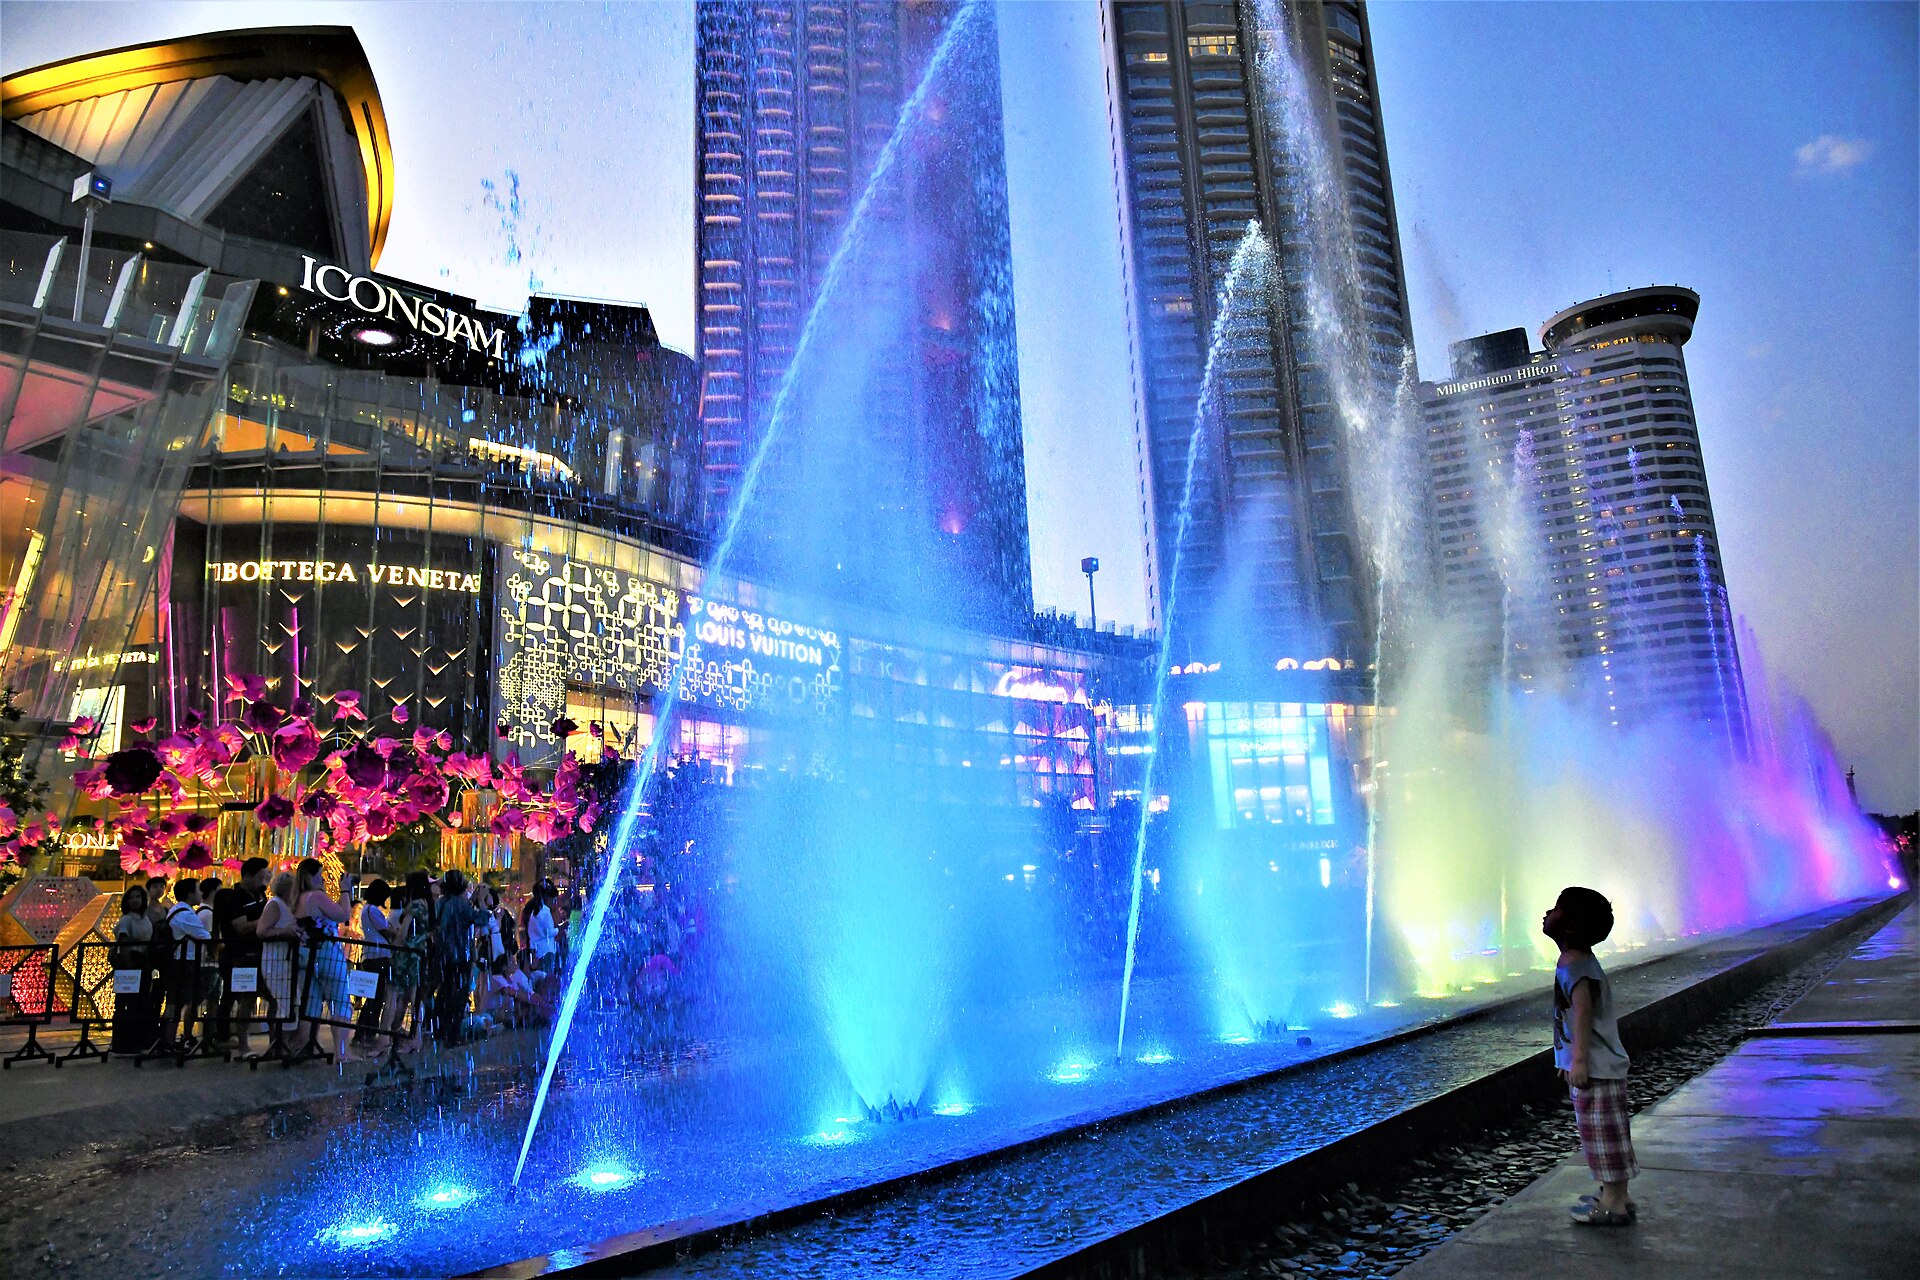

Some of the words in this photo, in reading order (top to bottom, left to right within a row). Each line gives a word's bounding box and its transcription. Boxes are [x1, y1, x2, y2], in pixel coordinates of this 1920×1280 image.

[300, 254, 506, 360] ICONSIAM
[1436, 373, 1512, 397] Millennium
[1517, 363, 1558, 380] Hilton
[220, 561, 357, 582] BOTTEGA
[366, 563, 480, 593] VENETA
[695, 620, 746, 649] LOUIS
[750, 632, 822, 666] VUITTON
